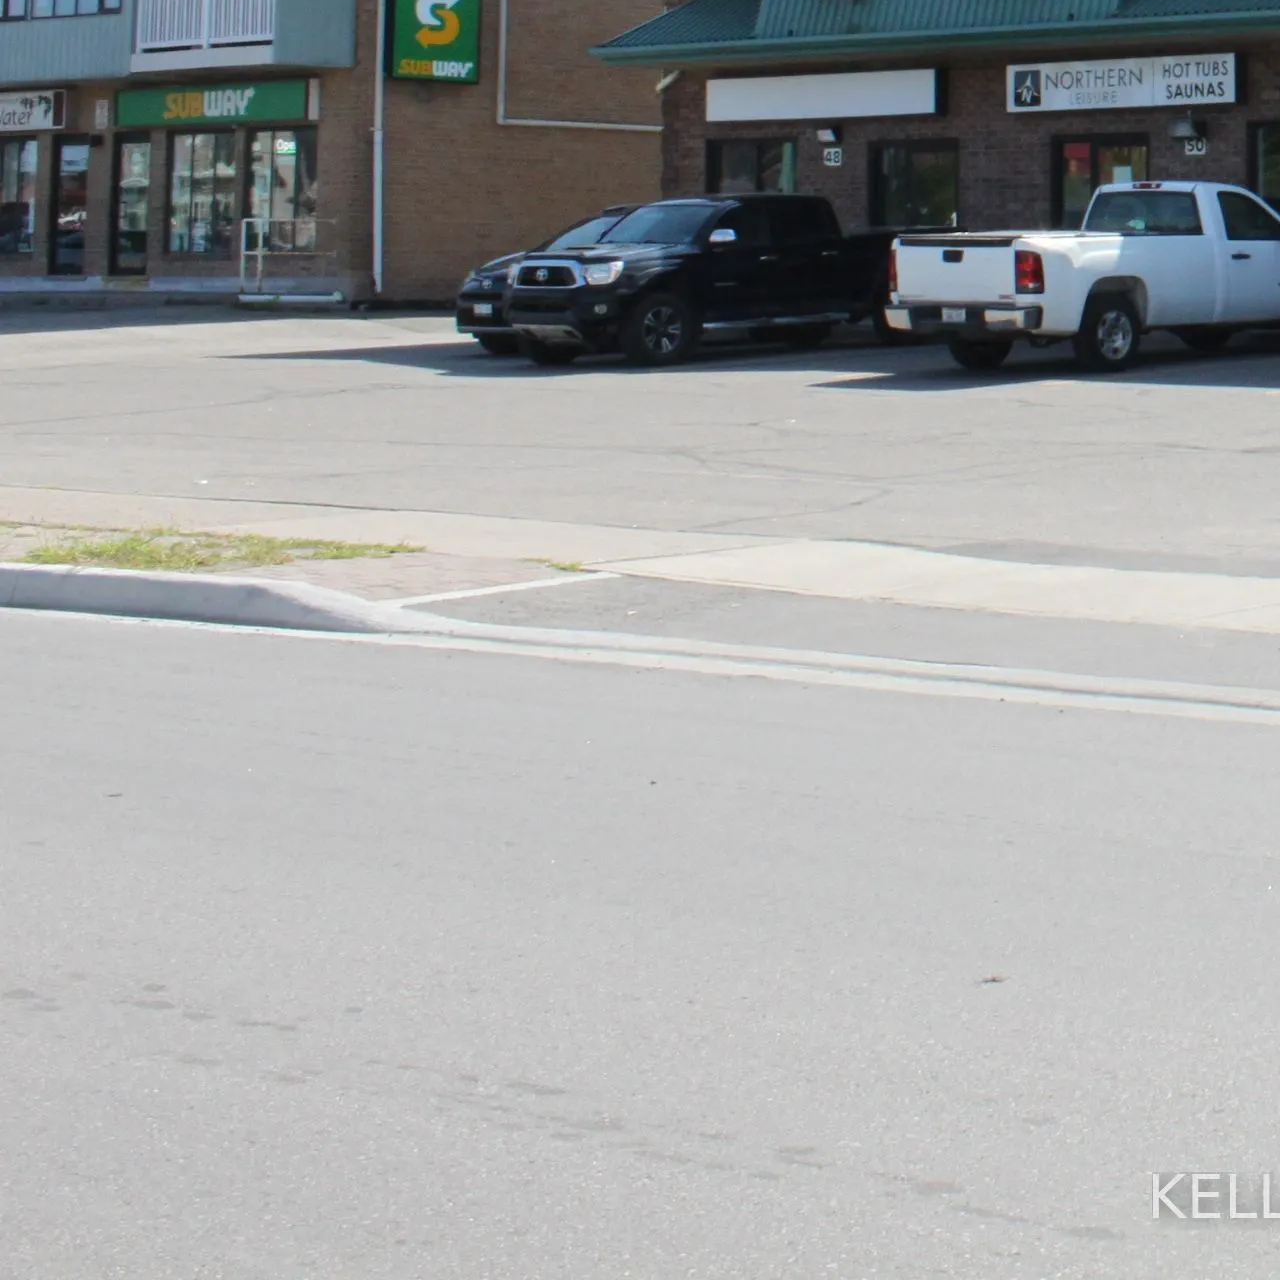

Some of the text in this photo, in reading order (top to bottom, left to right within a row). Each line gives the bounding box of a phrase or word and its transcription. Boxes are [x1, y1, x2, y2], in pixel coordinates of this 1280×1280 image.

[398, 59, 474, 78] SUBWAY
[1162, 60, 1229, 79] HOT TUBS
[1044, 68, 1143, 91] NORTHERN
[1069, 90, 1119, 106] LEISURE
[1165, 81, 1226, 100] SAUNAS
[163, 85, 256, 121] SUBWAY
[1187, 138, 1205, 153] 50
[825, 150, 841, 164] 48
